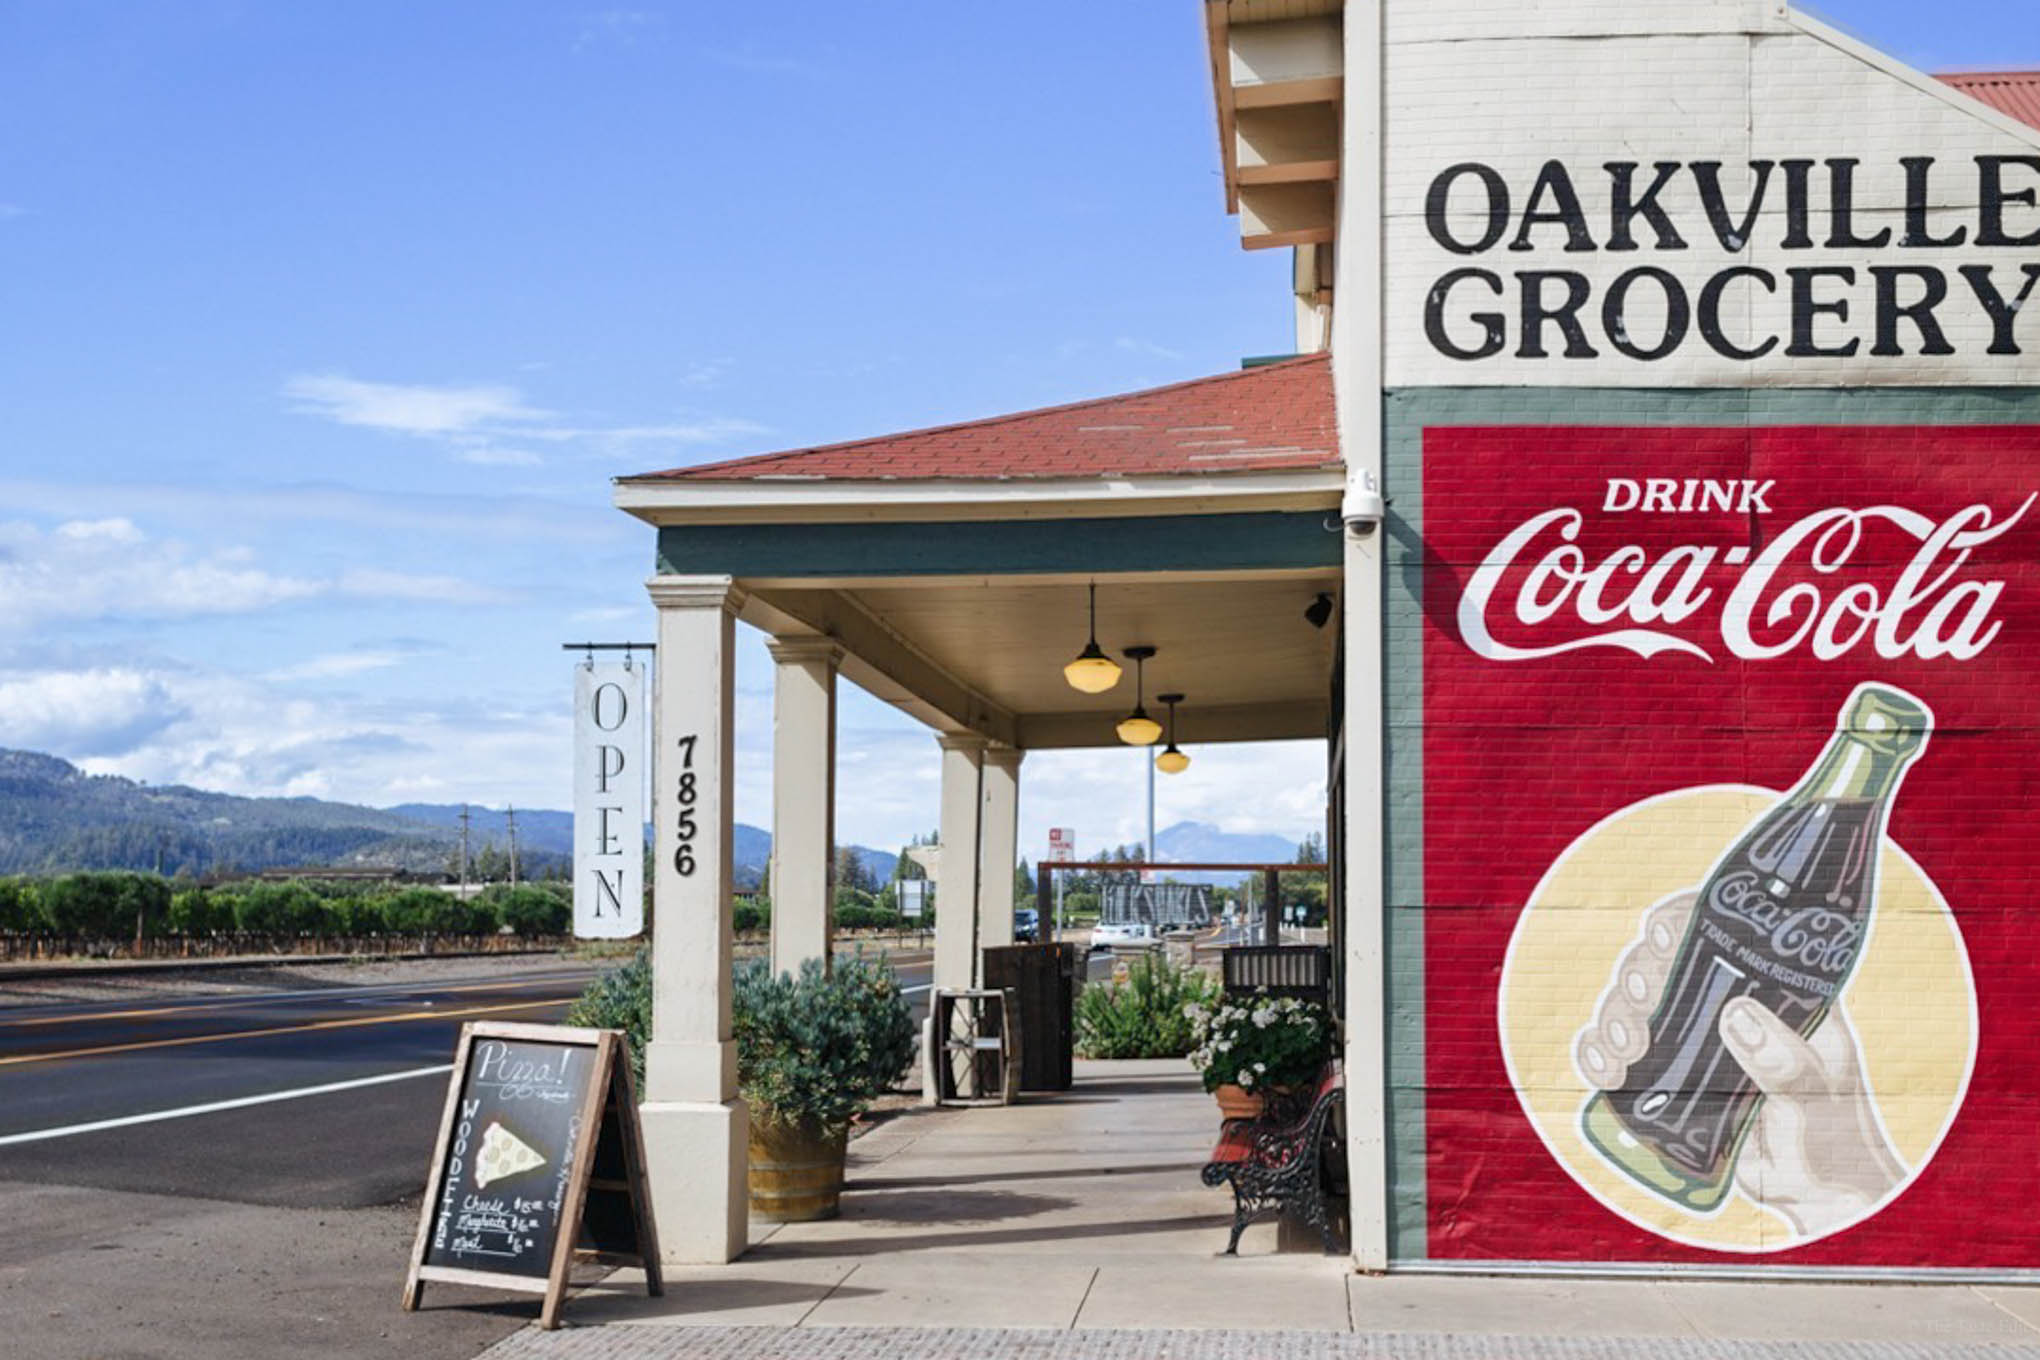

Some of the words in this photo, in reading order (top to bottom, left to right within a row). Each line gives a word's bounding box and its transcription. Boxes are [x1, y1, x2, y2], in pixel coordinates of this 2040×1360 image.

[1424, 155, 2040, 255] OAKVILLE
[1424, 263, 2040, 361] GROCERY
[1602, 478, 1775, 514] DRINK
[1457, 491, 2039, 664] Coca-Cola
[591, 682, 628, 917] OPEN
[674, 735, 698, 878] 7856
[1700, 918, 1738, 952] TRADE
[1736, 945, 1770, 974] MARK
[475, 1040, 572, 1088] Pizza!
